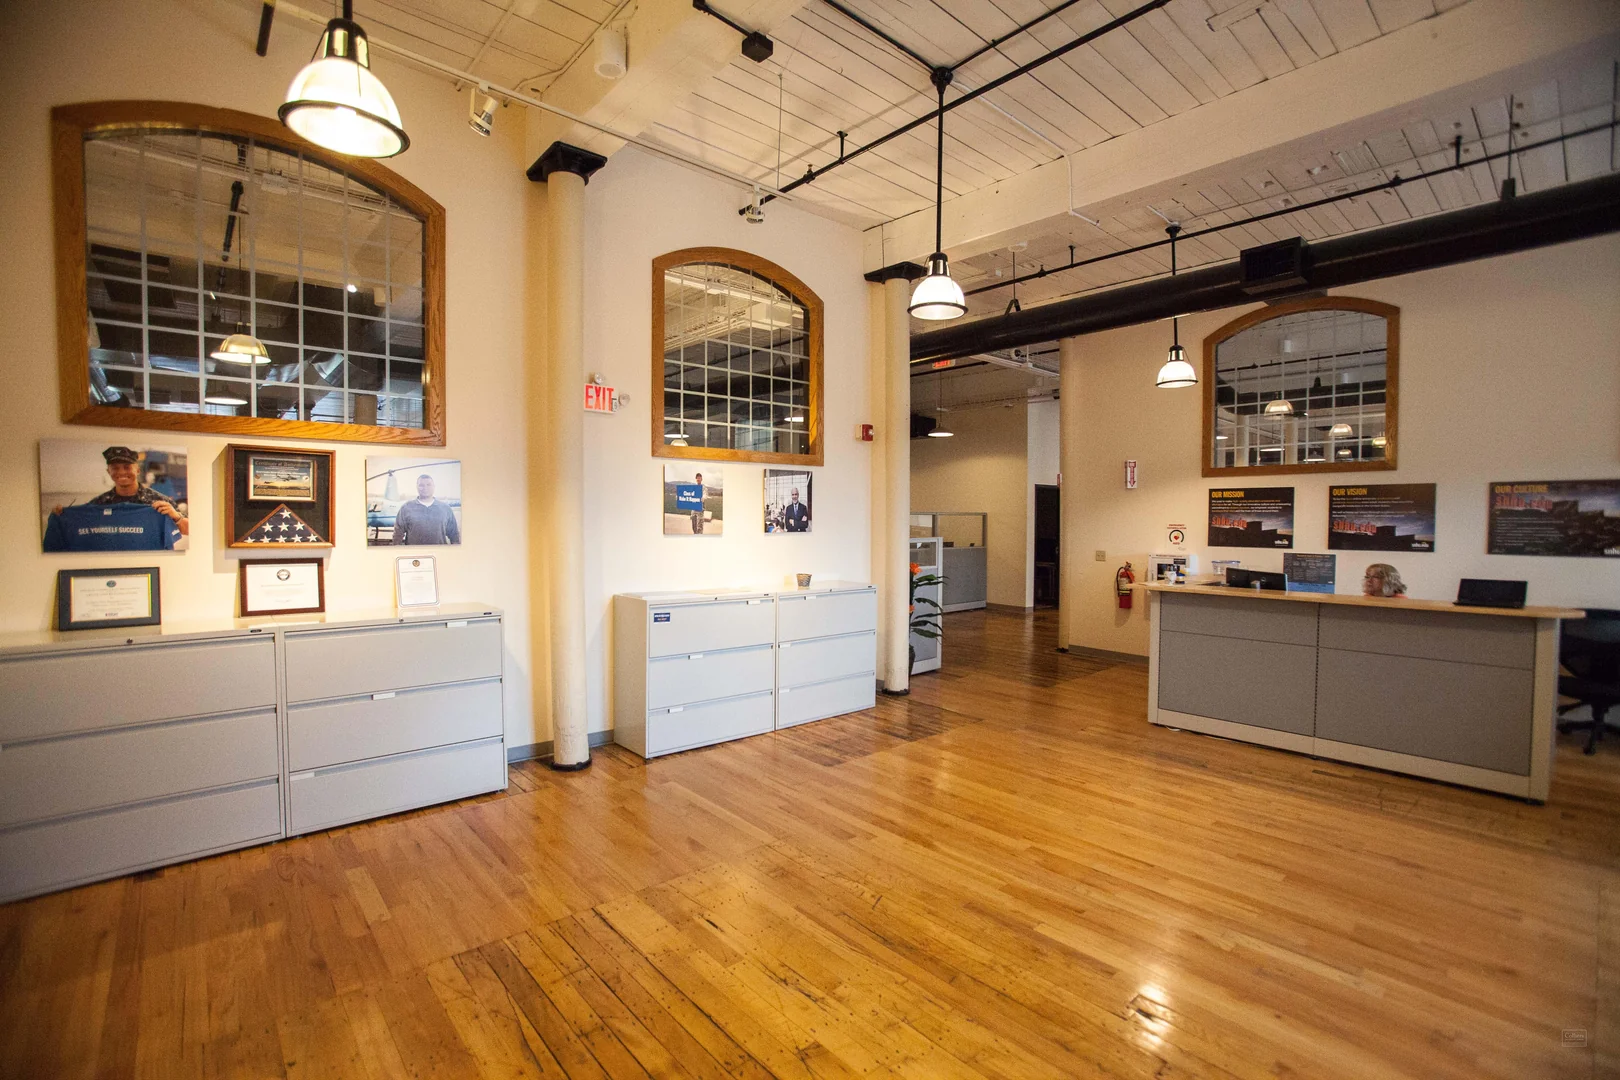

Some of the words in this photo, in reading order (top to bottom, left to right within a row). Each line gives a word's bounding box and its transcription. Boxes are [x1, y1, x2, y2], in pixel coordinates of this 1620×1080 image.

[585, 384, 615, 412] EXIT
[1332, 488, 1346, 496] OUR
[1347, 487, 1368, 496] VISION
[1495, 485, 1512, 493] OUR
[1513, 484, 1549, 493] CULTURE
[78, 527, 90, 535] SEE
[90, 526, 118, 534] YOURSELF
[118, 526, 144, 534] SUCCEED
